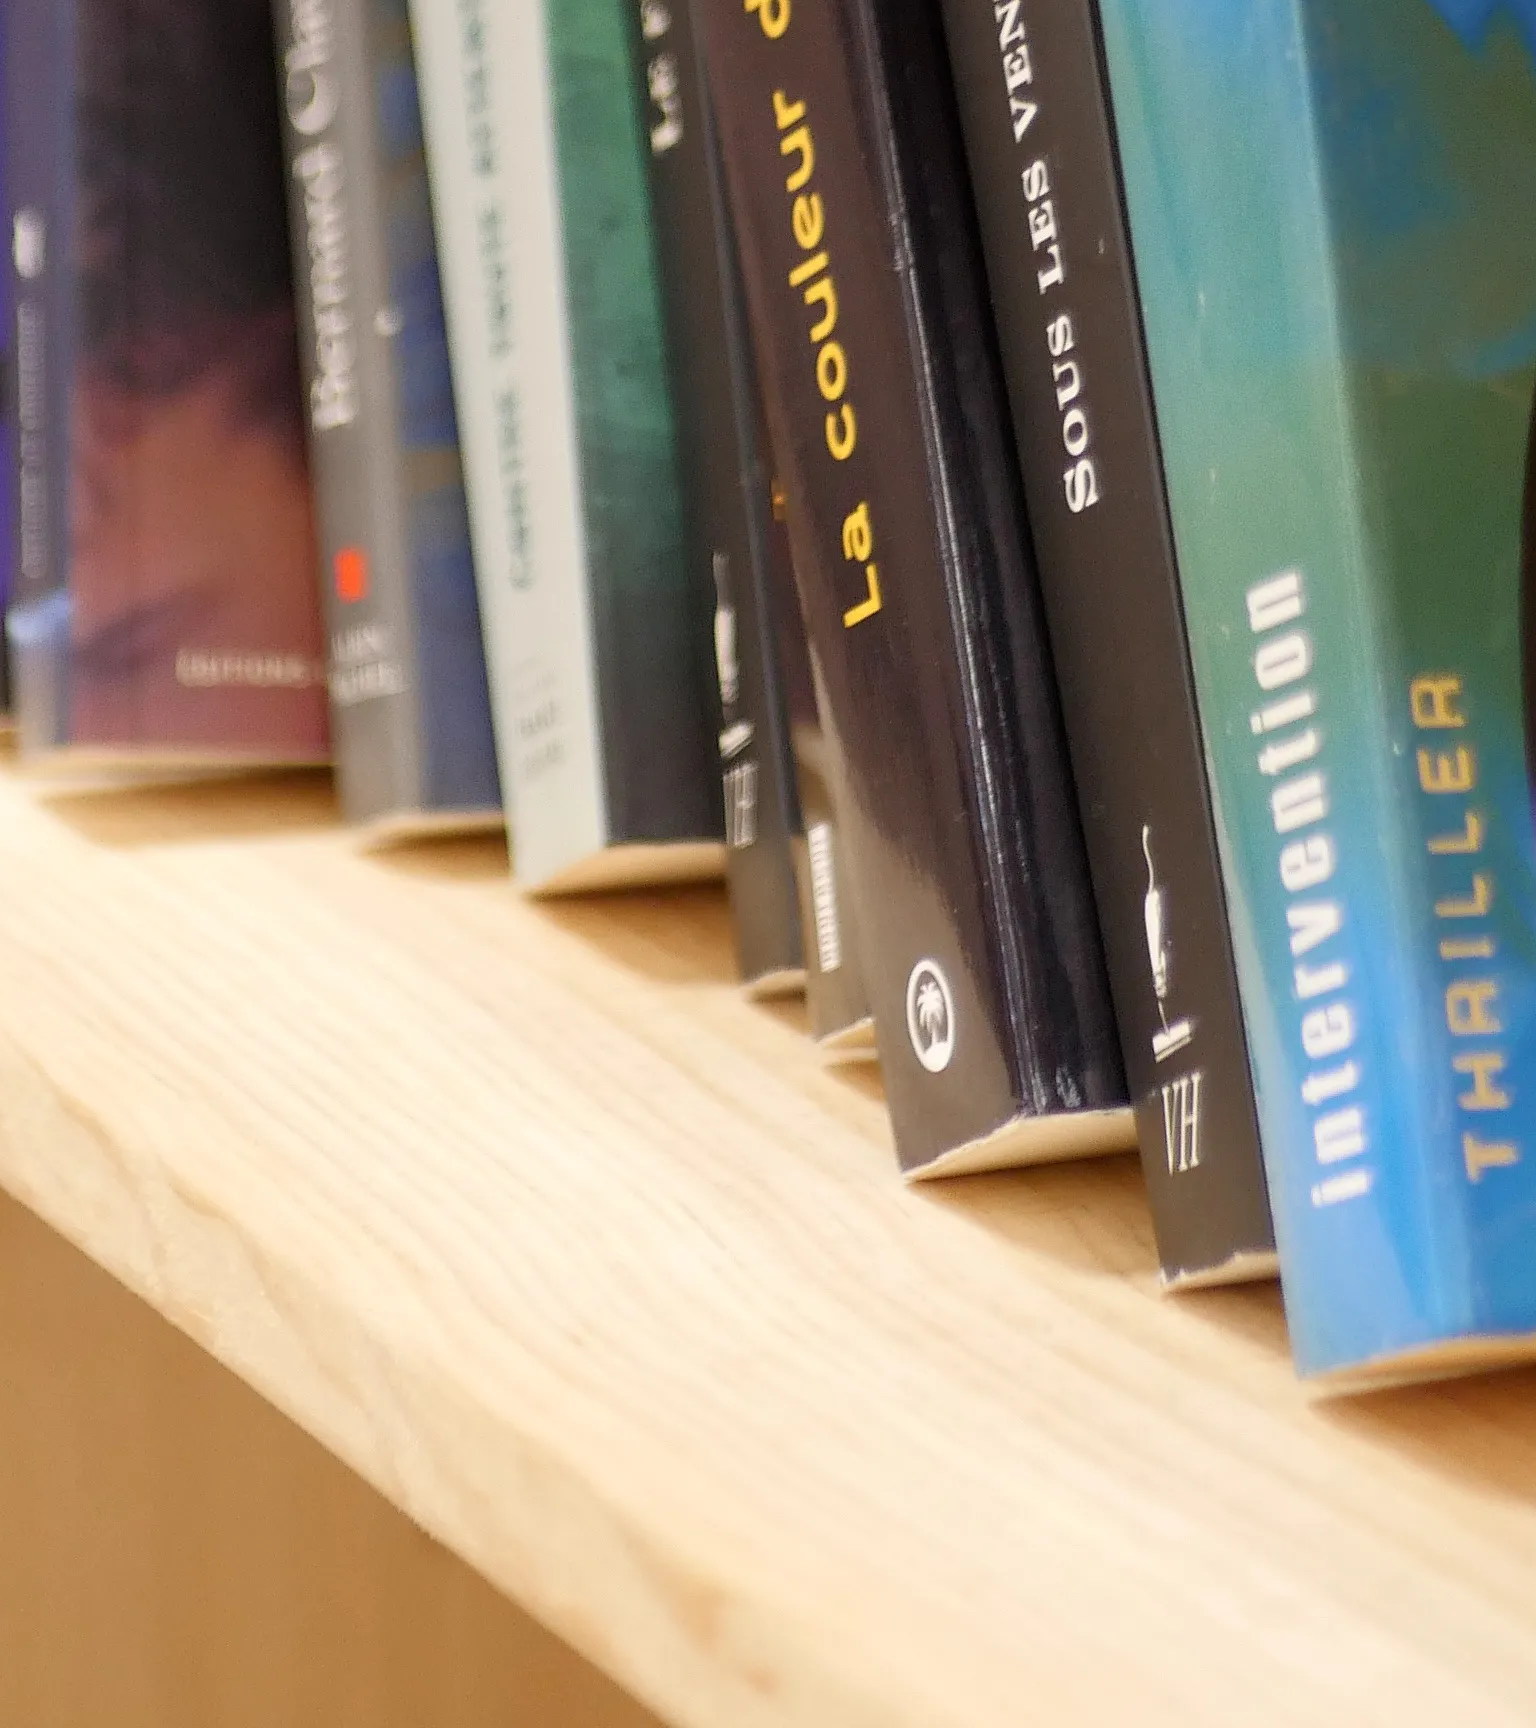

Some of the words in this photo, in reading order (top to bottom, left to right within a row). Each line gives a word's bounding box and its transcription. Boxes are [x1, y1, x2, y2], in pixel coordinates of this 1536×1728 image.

[767, 87, 860, 461] couleur
[1018, 159, 1069, 294] LES
[1041, 313, 1102, 514] SOUS
[834, 500, 885, 629] La
[1244, 569, 1371, 1208] intervention
[1410, 671, 1520, 1183] THRILLER
[1158, 1069, 1204, 1176] VH
